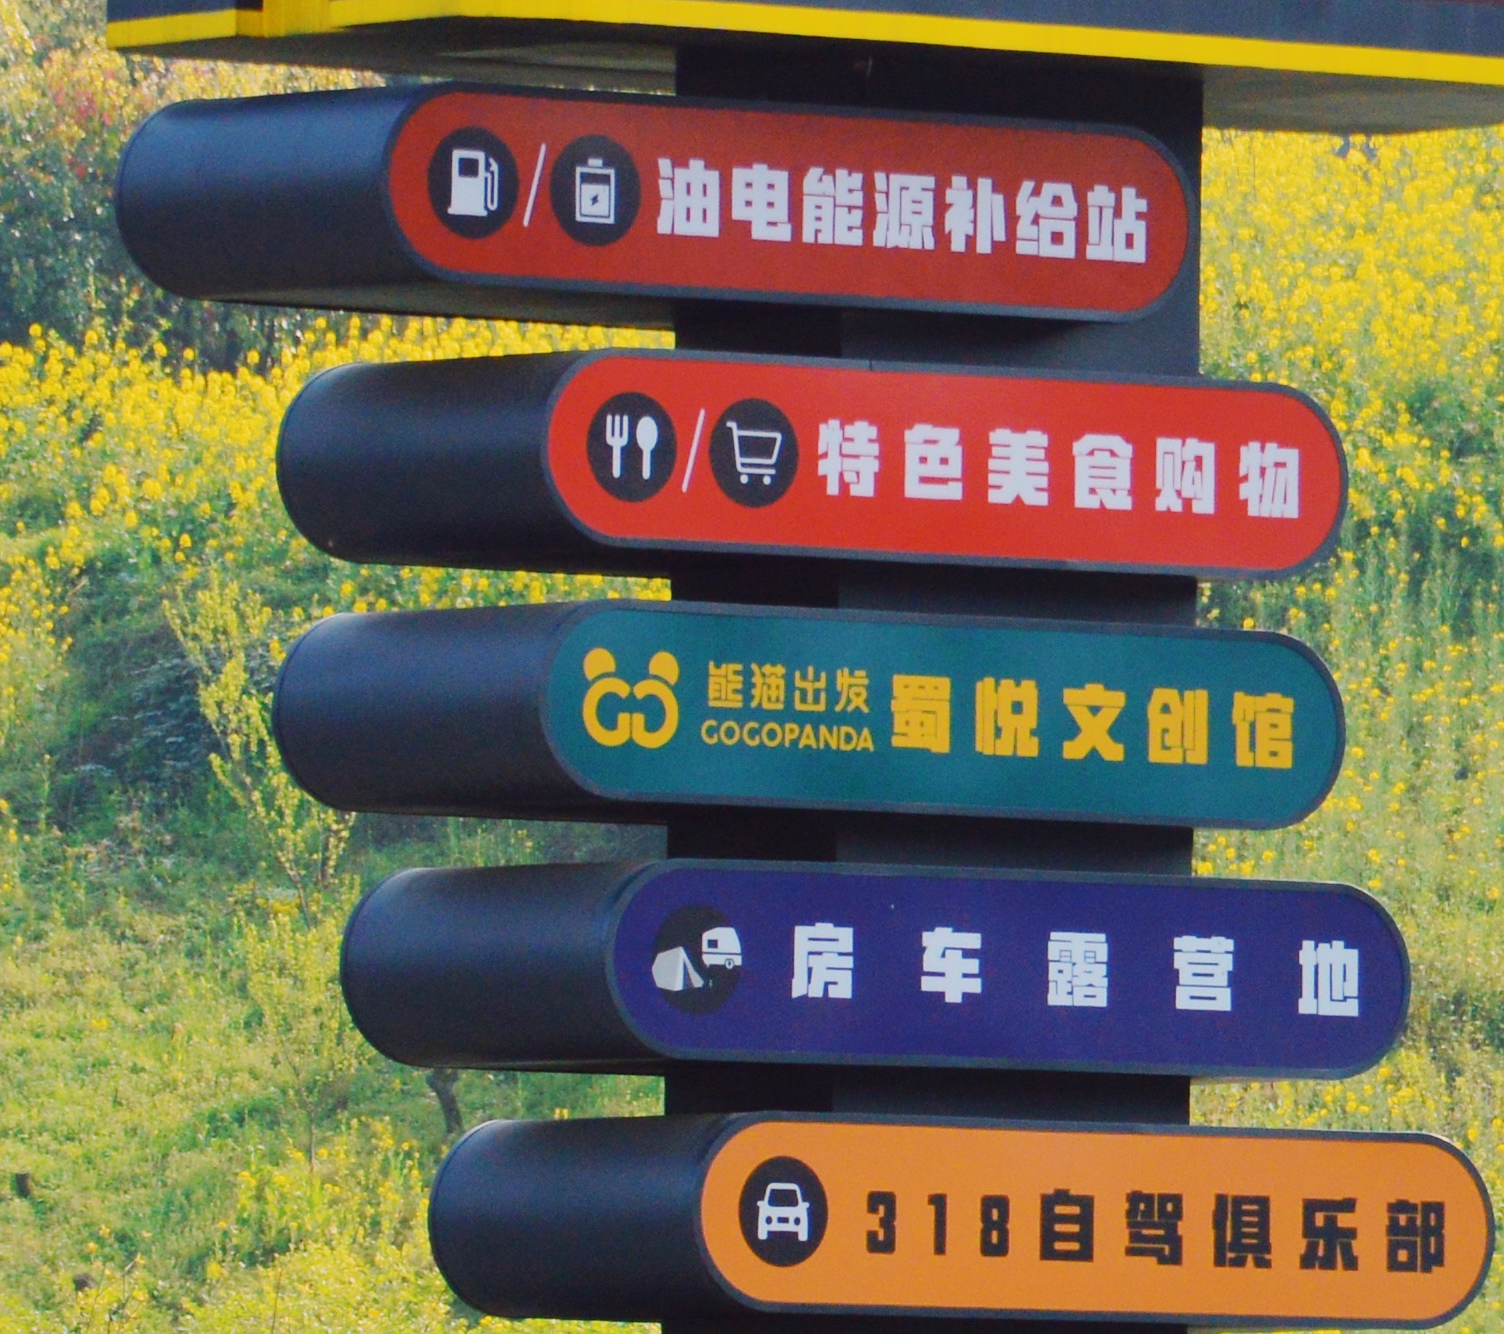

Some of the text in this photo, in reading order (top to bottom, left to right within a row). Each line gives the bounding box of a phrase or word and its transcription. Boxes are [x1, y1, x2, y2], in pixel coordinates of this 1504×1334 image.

[656, 156, 1148, 264] 油电能源补给站
[817, 419, 1301, 519] 特色美食购物
[707, 660, 870, 713] 熊猫出发
[891, 674, 1296, 770] 蜀悦文创馆
[700, 719, 875, 753] GOGOPANDA
[791, 921, 1360, 1018] 房车露营地
[866, 1187, 1447, 1274] 318自驾俱乐部
